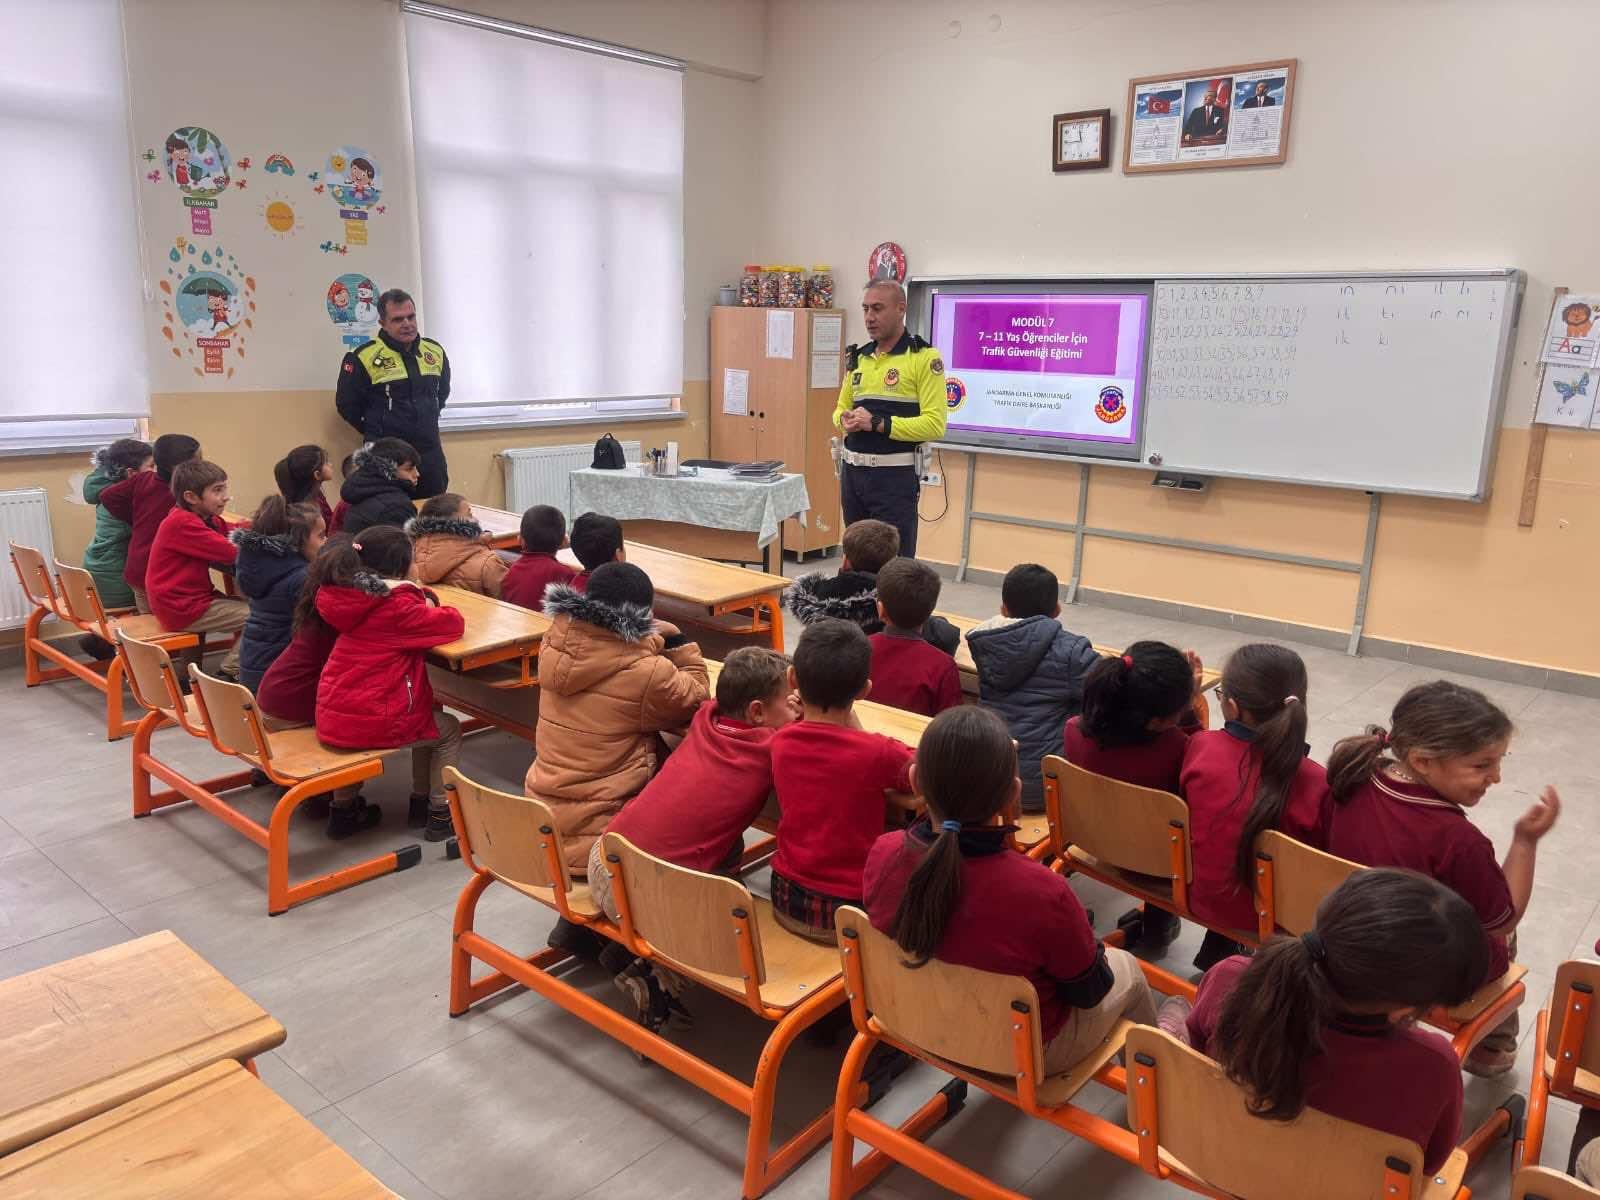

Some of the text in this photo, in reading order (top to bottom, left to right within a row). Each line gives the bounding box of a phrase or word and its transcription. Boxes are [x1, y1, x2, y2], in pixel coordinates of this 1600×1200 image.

[1011, 316, 1055, 328] MODÜL 7
[978, 332, 985, 341] 7
[993, 333, 1004, 342] 11
[1006, 332, 1021, 344] Yaş
[1022, 330, 1070, 344] Öğrenciler
[1071, 332, 1088, 346] İçin
[981, 346, 1082, 360] Trafik Güvenliği Eğitimi
[1016, 390, 1033, 398] GENEL
